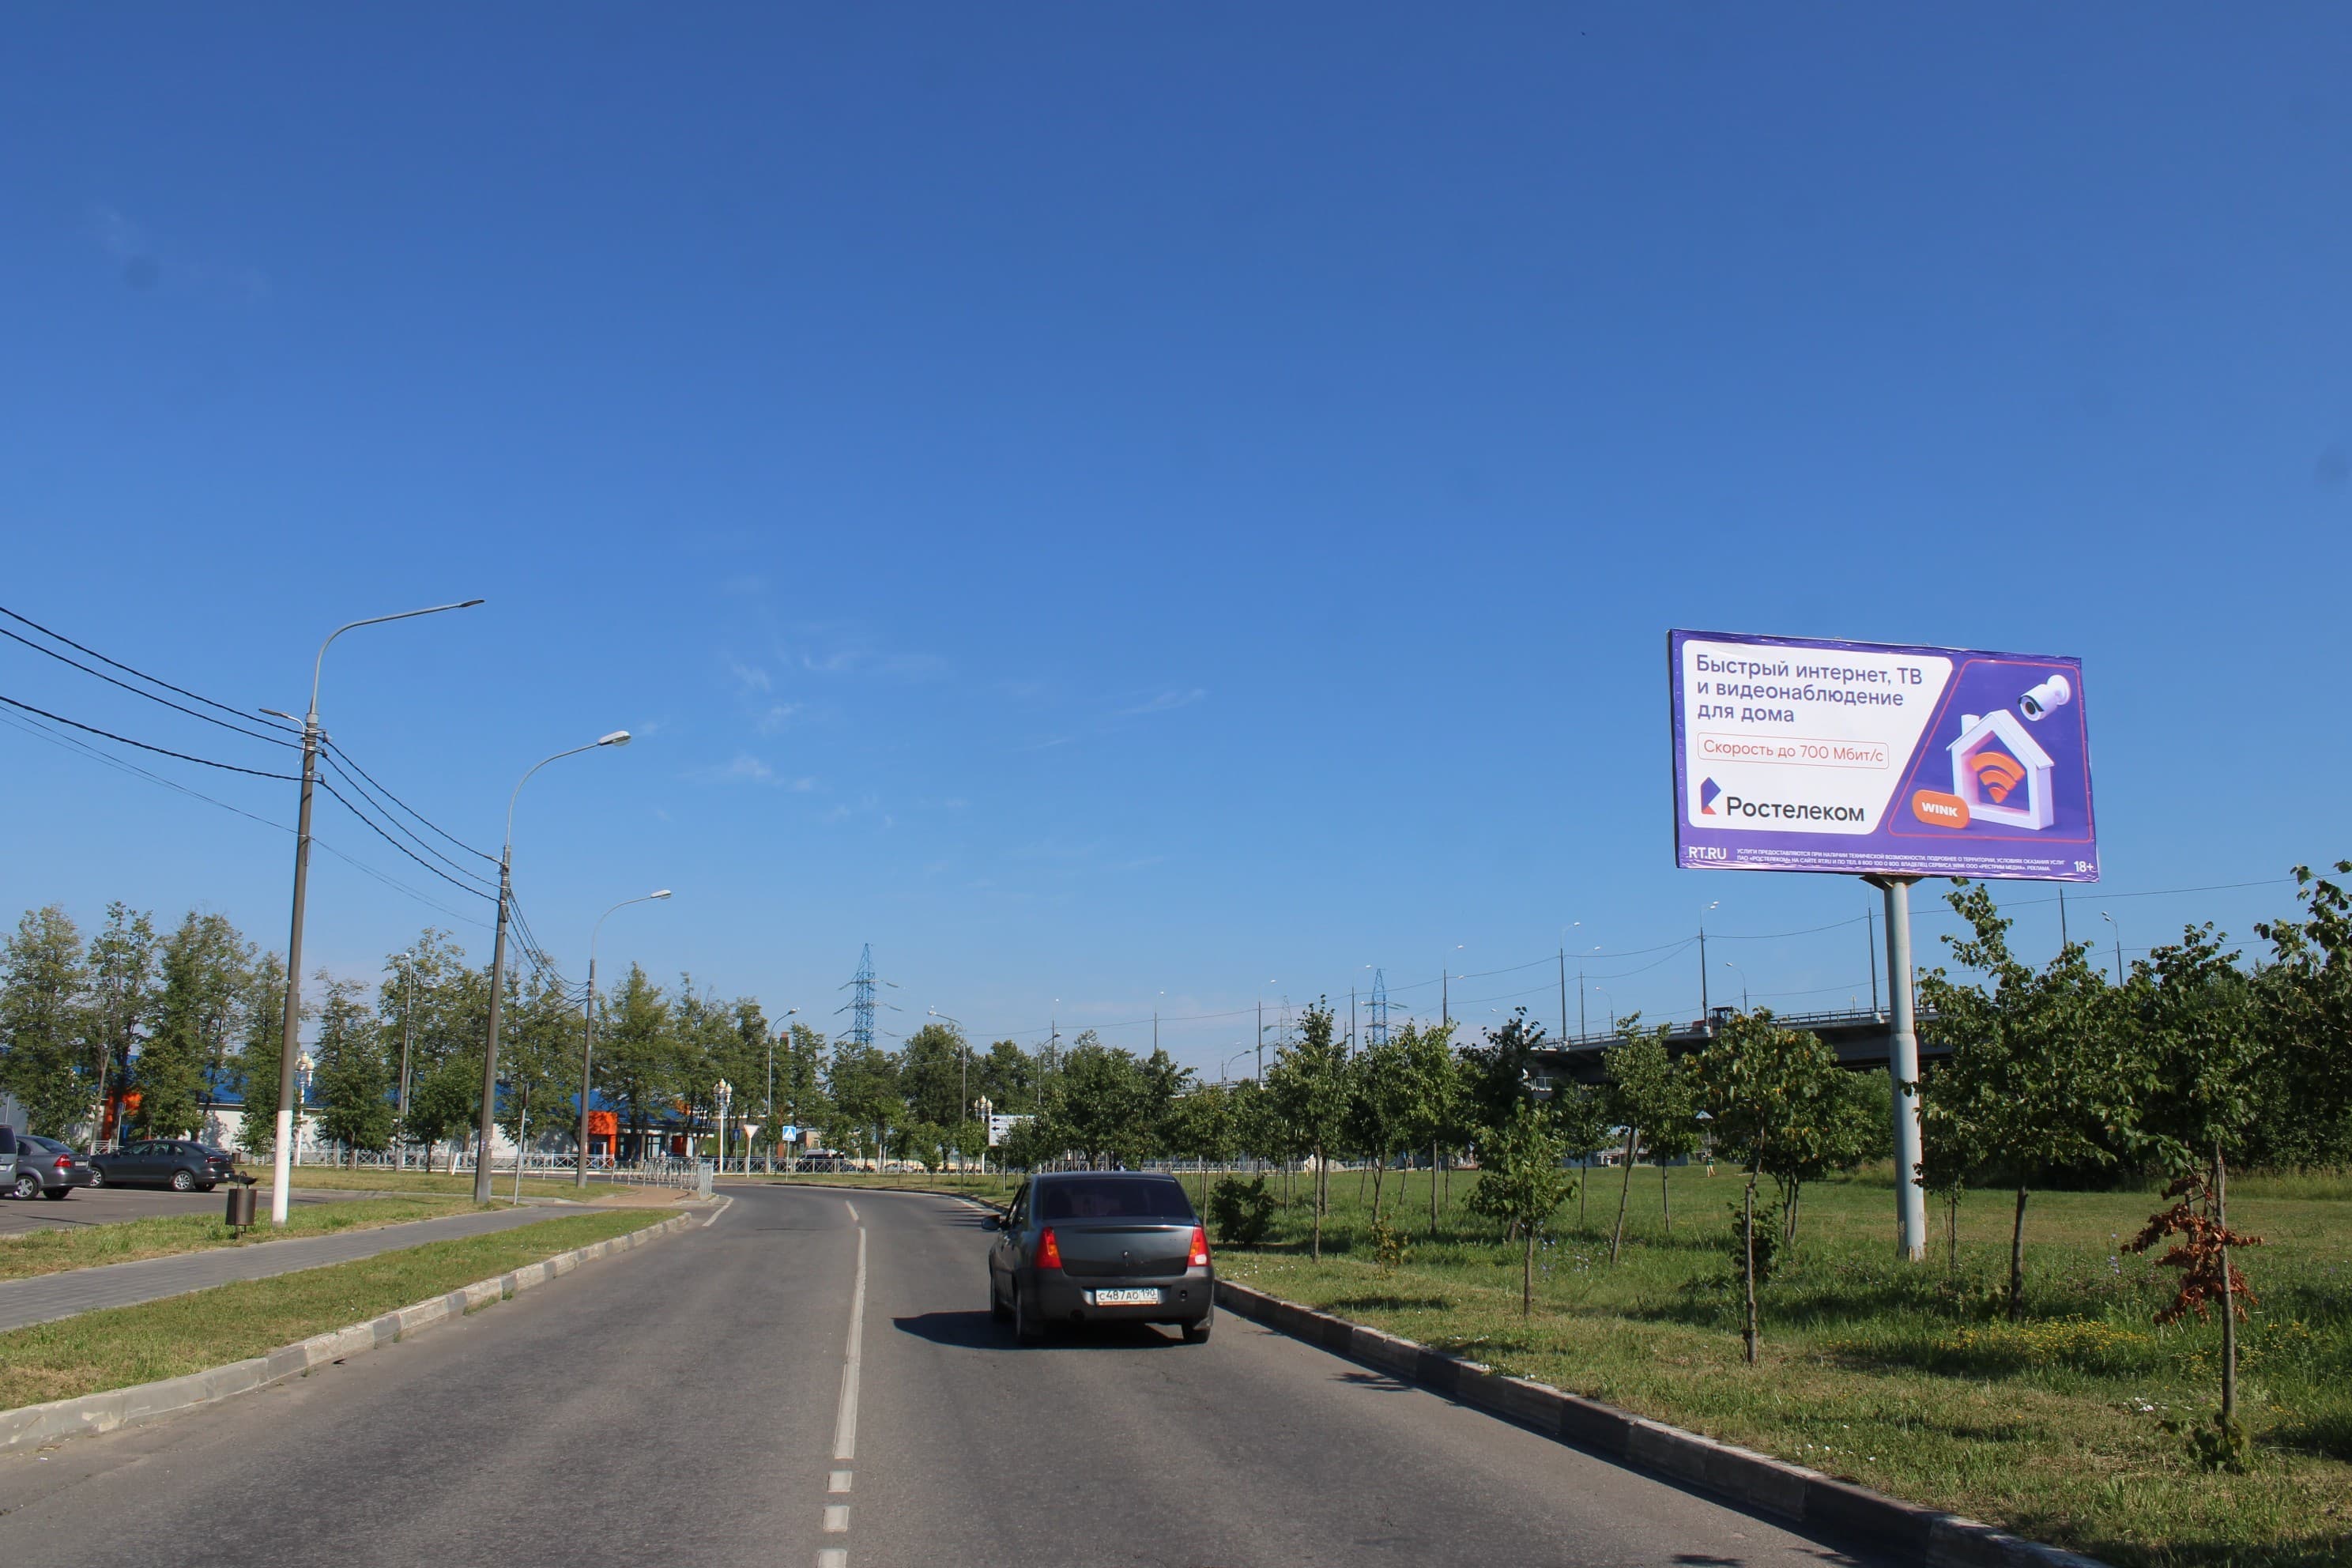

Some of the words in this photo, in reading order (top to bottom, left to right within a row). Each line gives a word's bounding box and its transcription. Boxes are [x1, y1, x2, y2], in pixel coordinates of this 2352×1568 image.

[1696, 653, 1789, 680] Быстрый
[1796, 665, 1891, 686] интернет,
[1897, 666, 1923, 685] ТВ
[1697, 680, 1709, 695] и
[1716, 682, 1904, 707] видеонаблюдение
[1698, 703, 1735, 720] для
[1741, 707, 1795, 723] дома
[1703, 739, 1774, 756] Скорость
[1777, 746, 1796, 759] до
[1800, 744, 1830, 760] 700
[1834, 747, 1884, 763] Мбит/с
[1726, 796, 1865, 822] Ростелеком
[1921, 801, 1958, 817] WINK
[1688, 846, 1727, 860] RT.RU
[2073, 860, 2094, 873] 18+
